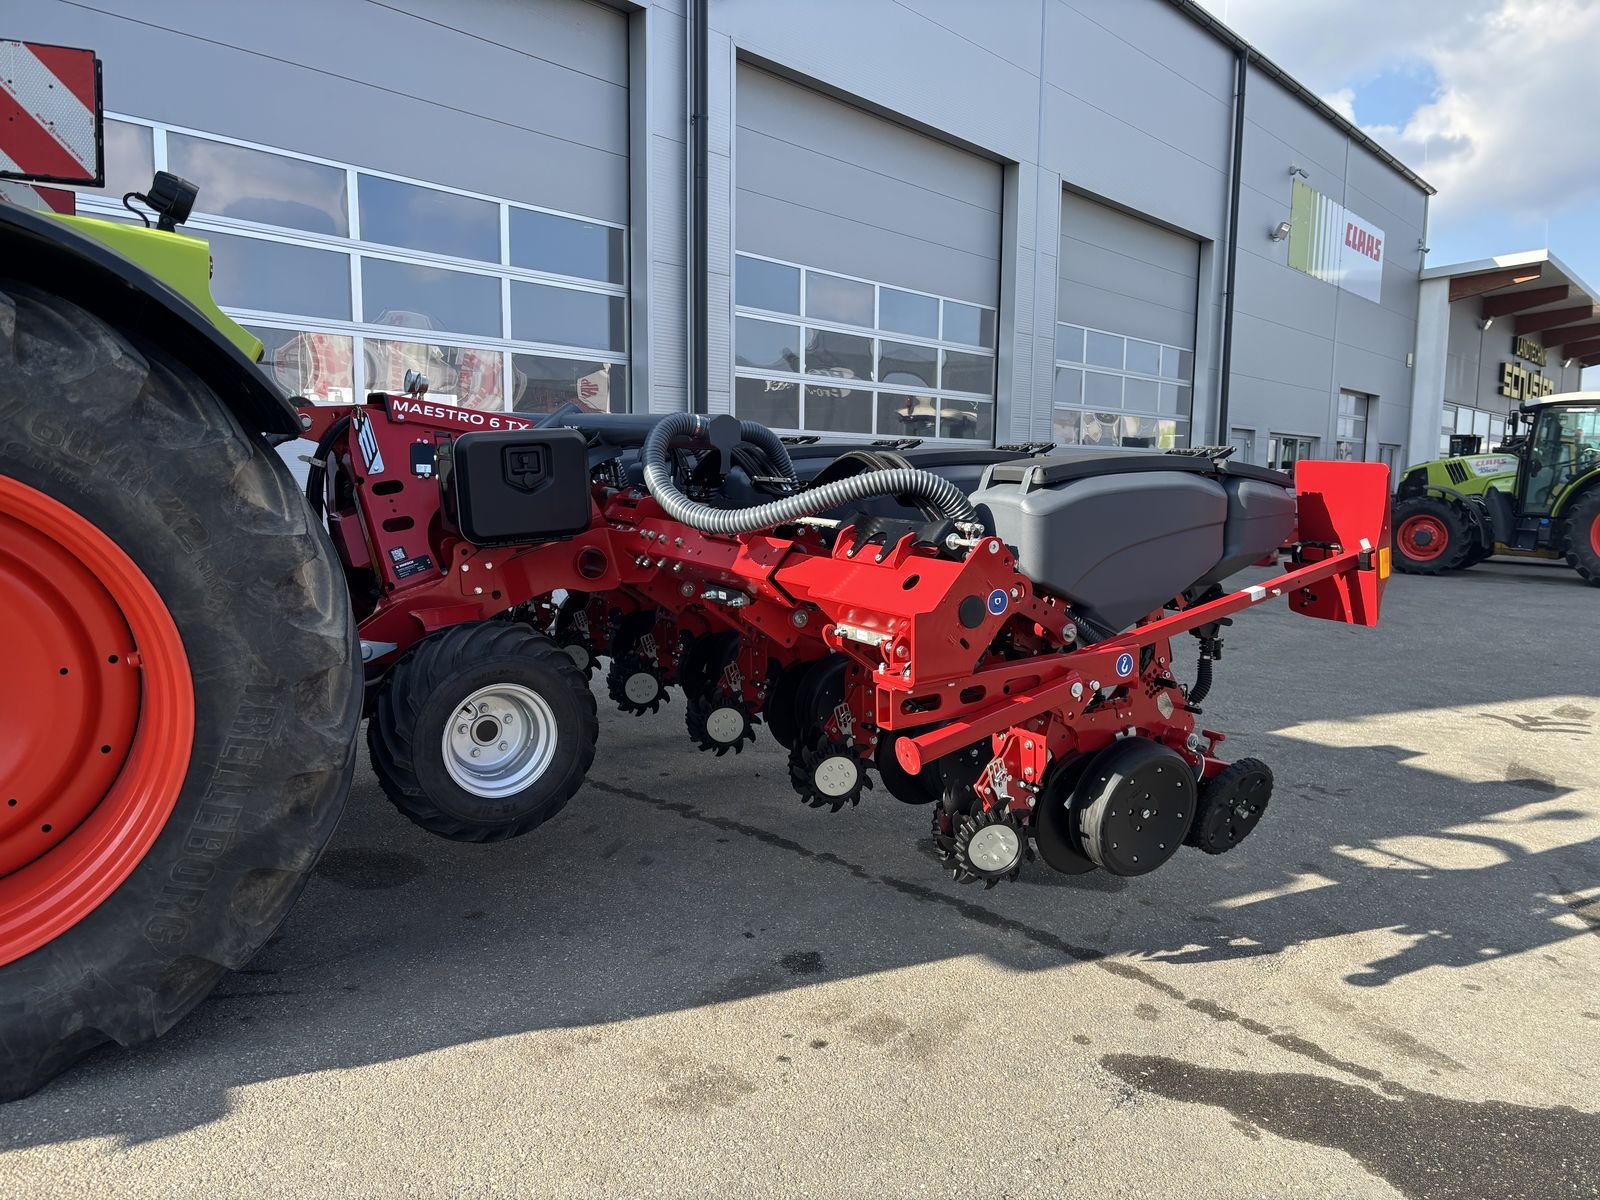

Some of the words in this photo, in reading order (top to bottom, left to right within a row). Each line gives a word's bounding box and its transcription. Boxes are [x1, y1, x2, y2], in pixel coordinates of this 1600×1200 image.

[1345, 222, 1381, 262] CLAAS
[393, 399, 484, 425] MAESTRO
[489, 417, 500, 429] 6
[505, 420, 529, 431] TX
[1476, 458, 1508, 467] CLAAS
